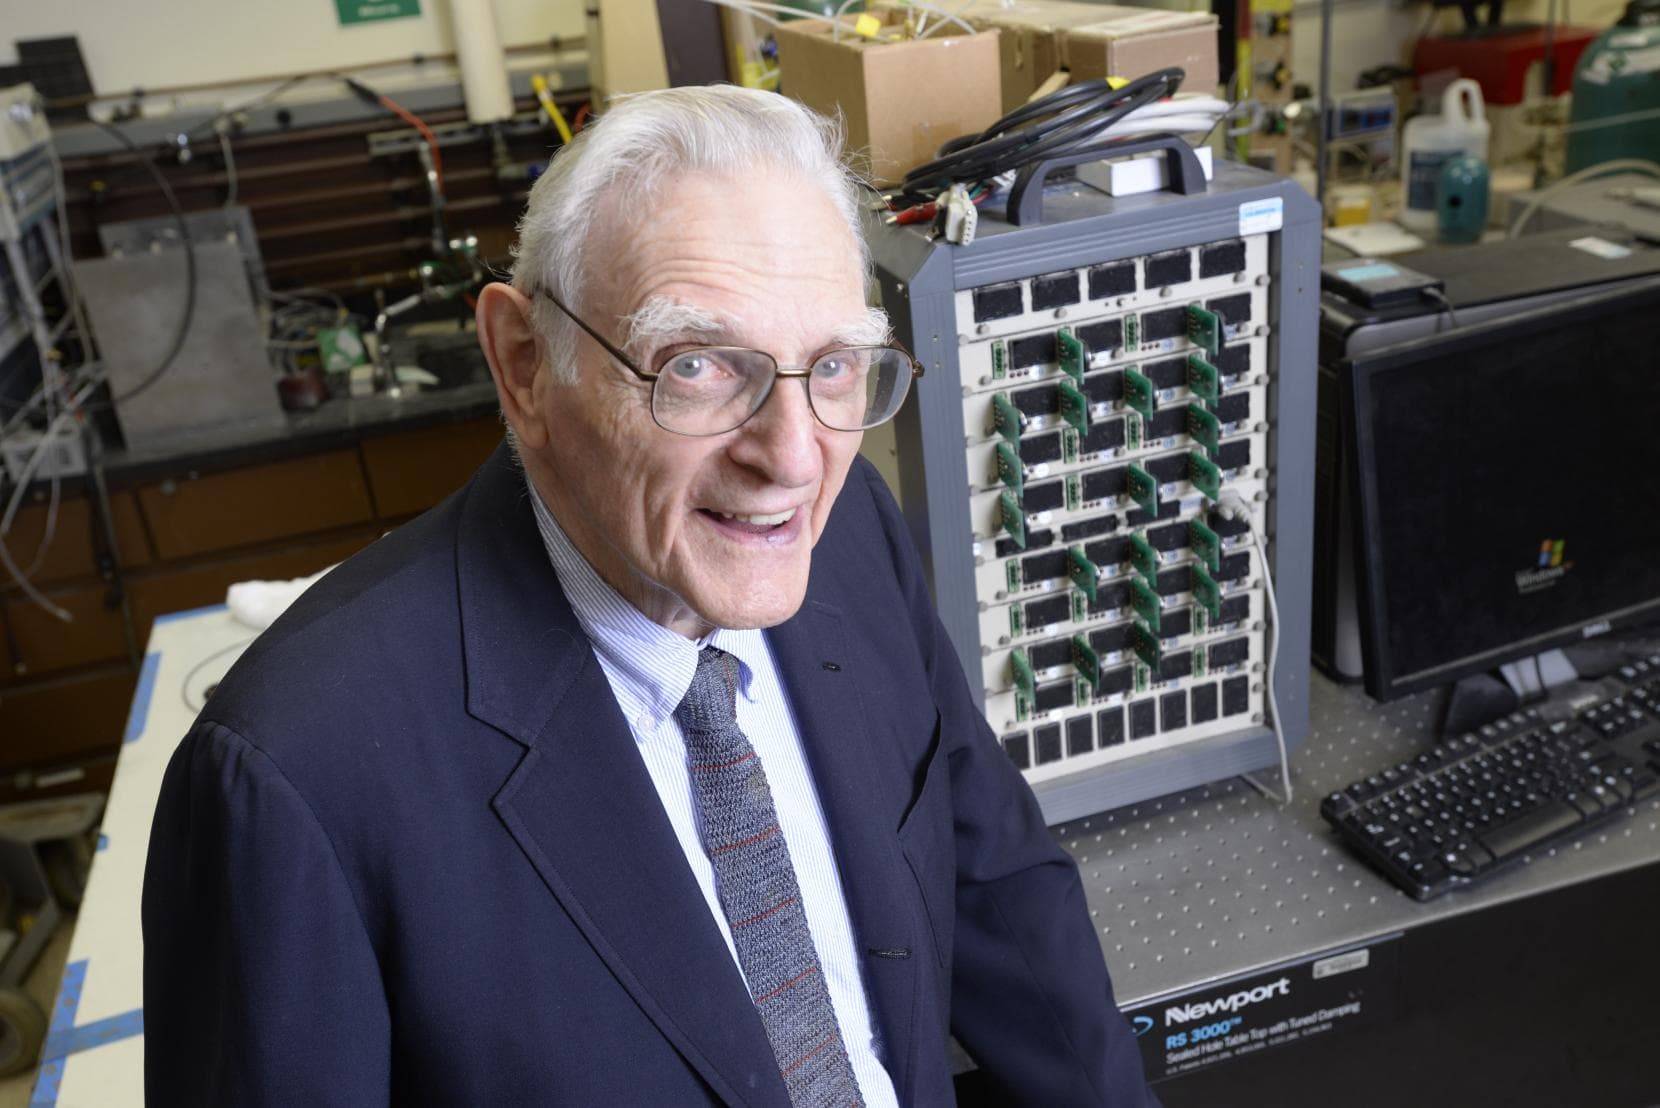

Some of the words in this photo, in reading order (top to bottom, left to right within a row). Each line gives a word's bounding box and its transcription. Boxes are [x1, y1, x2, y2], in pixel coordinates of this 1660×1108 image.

[1165, 977, 1290, 1027] Newport
[1165, 1032, 1188, 1050] RS
[1166, 1046, 1200, 1064] Sealed
[1201, 1040, 1224, 1054] Hole
[1224, 1032, 1250, 1047] Table
[1249, 1027, 1268, 1040] Top
[1268, 1020, 1289, 1035] with
[1288, 1011, 1318, 1029] Tuned
[1318, 1001, 1361, 1021] Damping
